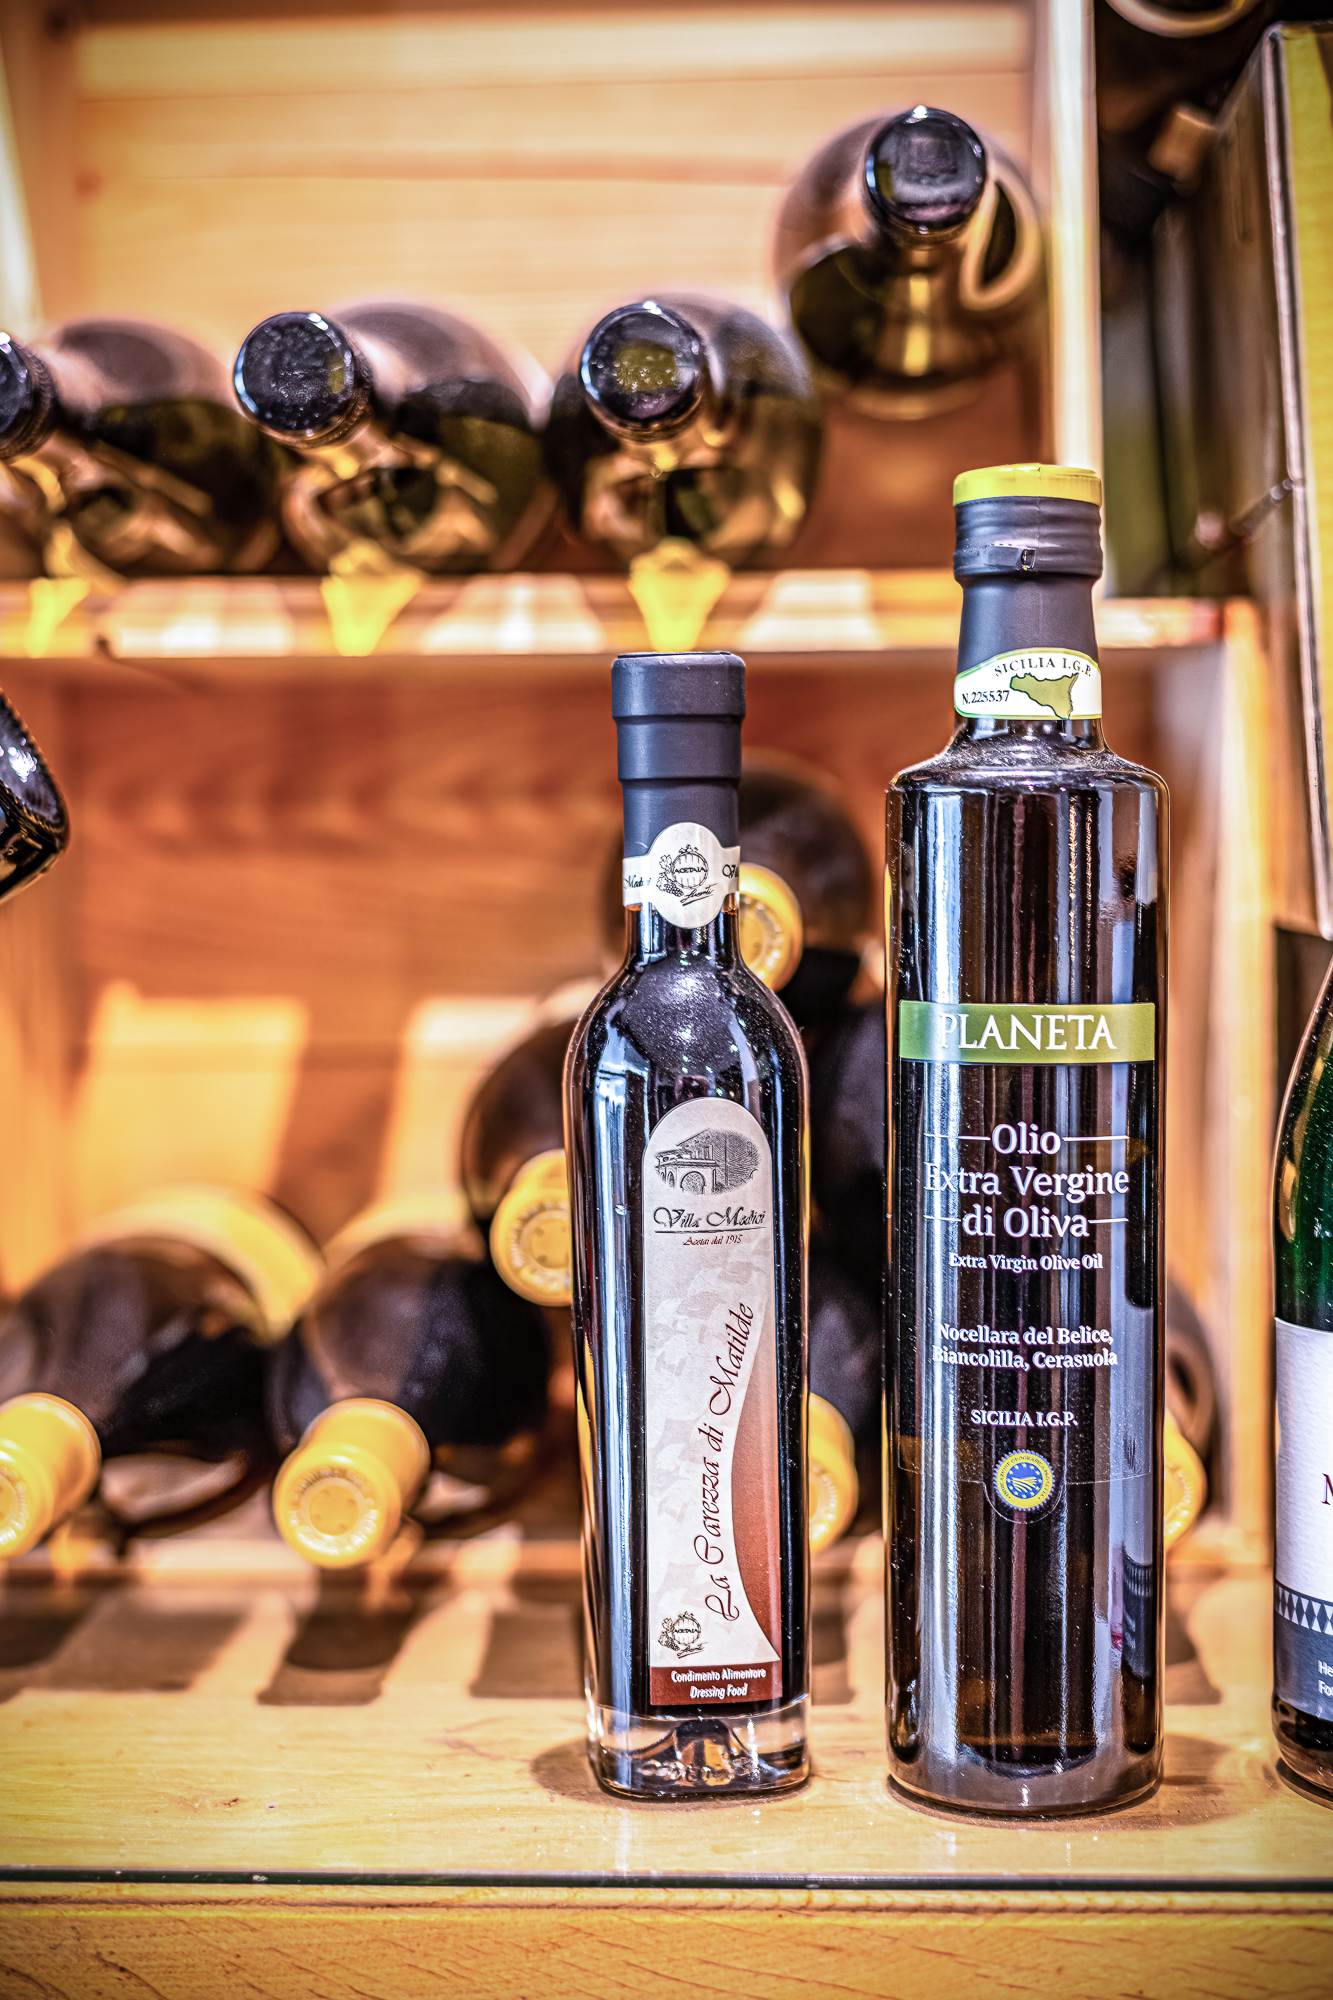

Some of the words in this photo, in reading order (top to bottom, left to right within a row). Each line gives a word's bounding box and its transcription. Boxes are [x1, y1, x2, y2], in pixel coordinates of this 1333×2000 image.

[994, 657, 1056, 677] SICILIA
[1062, 657, 1092, 677] I.G.P.
[961, 689, 1010, 705] N.225537
[939, 1014, 1117, 1050] PLANETA
[991, 1121, 1061, 1155] Olio
[924, 1162, 1001, 1195] Extra
[1009, 1164, 1130, 1204] Vergine
[653, 1206, 702, 1229] Villa
[706, 1206, 766, 1227] Medici
[962, 1203, 996, 1237] di
[1003, 1204, 1090, 1238] Oliva
[725, 1234, 743, 1245] 1915
[949, 1252, 987, 1269] Extra
[989, 1253, 1038, 1274] Virgin
[1039, 1254, 1080, 1271] Olive
[1082, 1252, 1103, 1269] Oil
[937, 1323, 1020, 1345] Nocellara
[1022, 1326, 1054, 1345] del
[1056, 1325, 1114, 1345] Belice,
[708, 1302, 754, 1417] Matilde
[932, 1345, 1030, 1371] Biancolilla,
[1032, 1348, 1118, 1369] Cerasuola
[970, 1409, 1034, 1427] SICILIA
[1035, 1411, 1078, 1427] I.G.P.
[697, 1422, 724, 1453] di
[671, 1669, 720, 1683] Condimento
[721, 1668, 767, 1681] Alimentare
[689, 1685, 726, 1699] Dressing
[726, 1682, 749, 1697] Food
